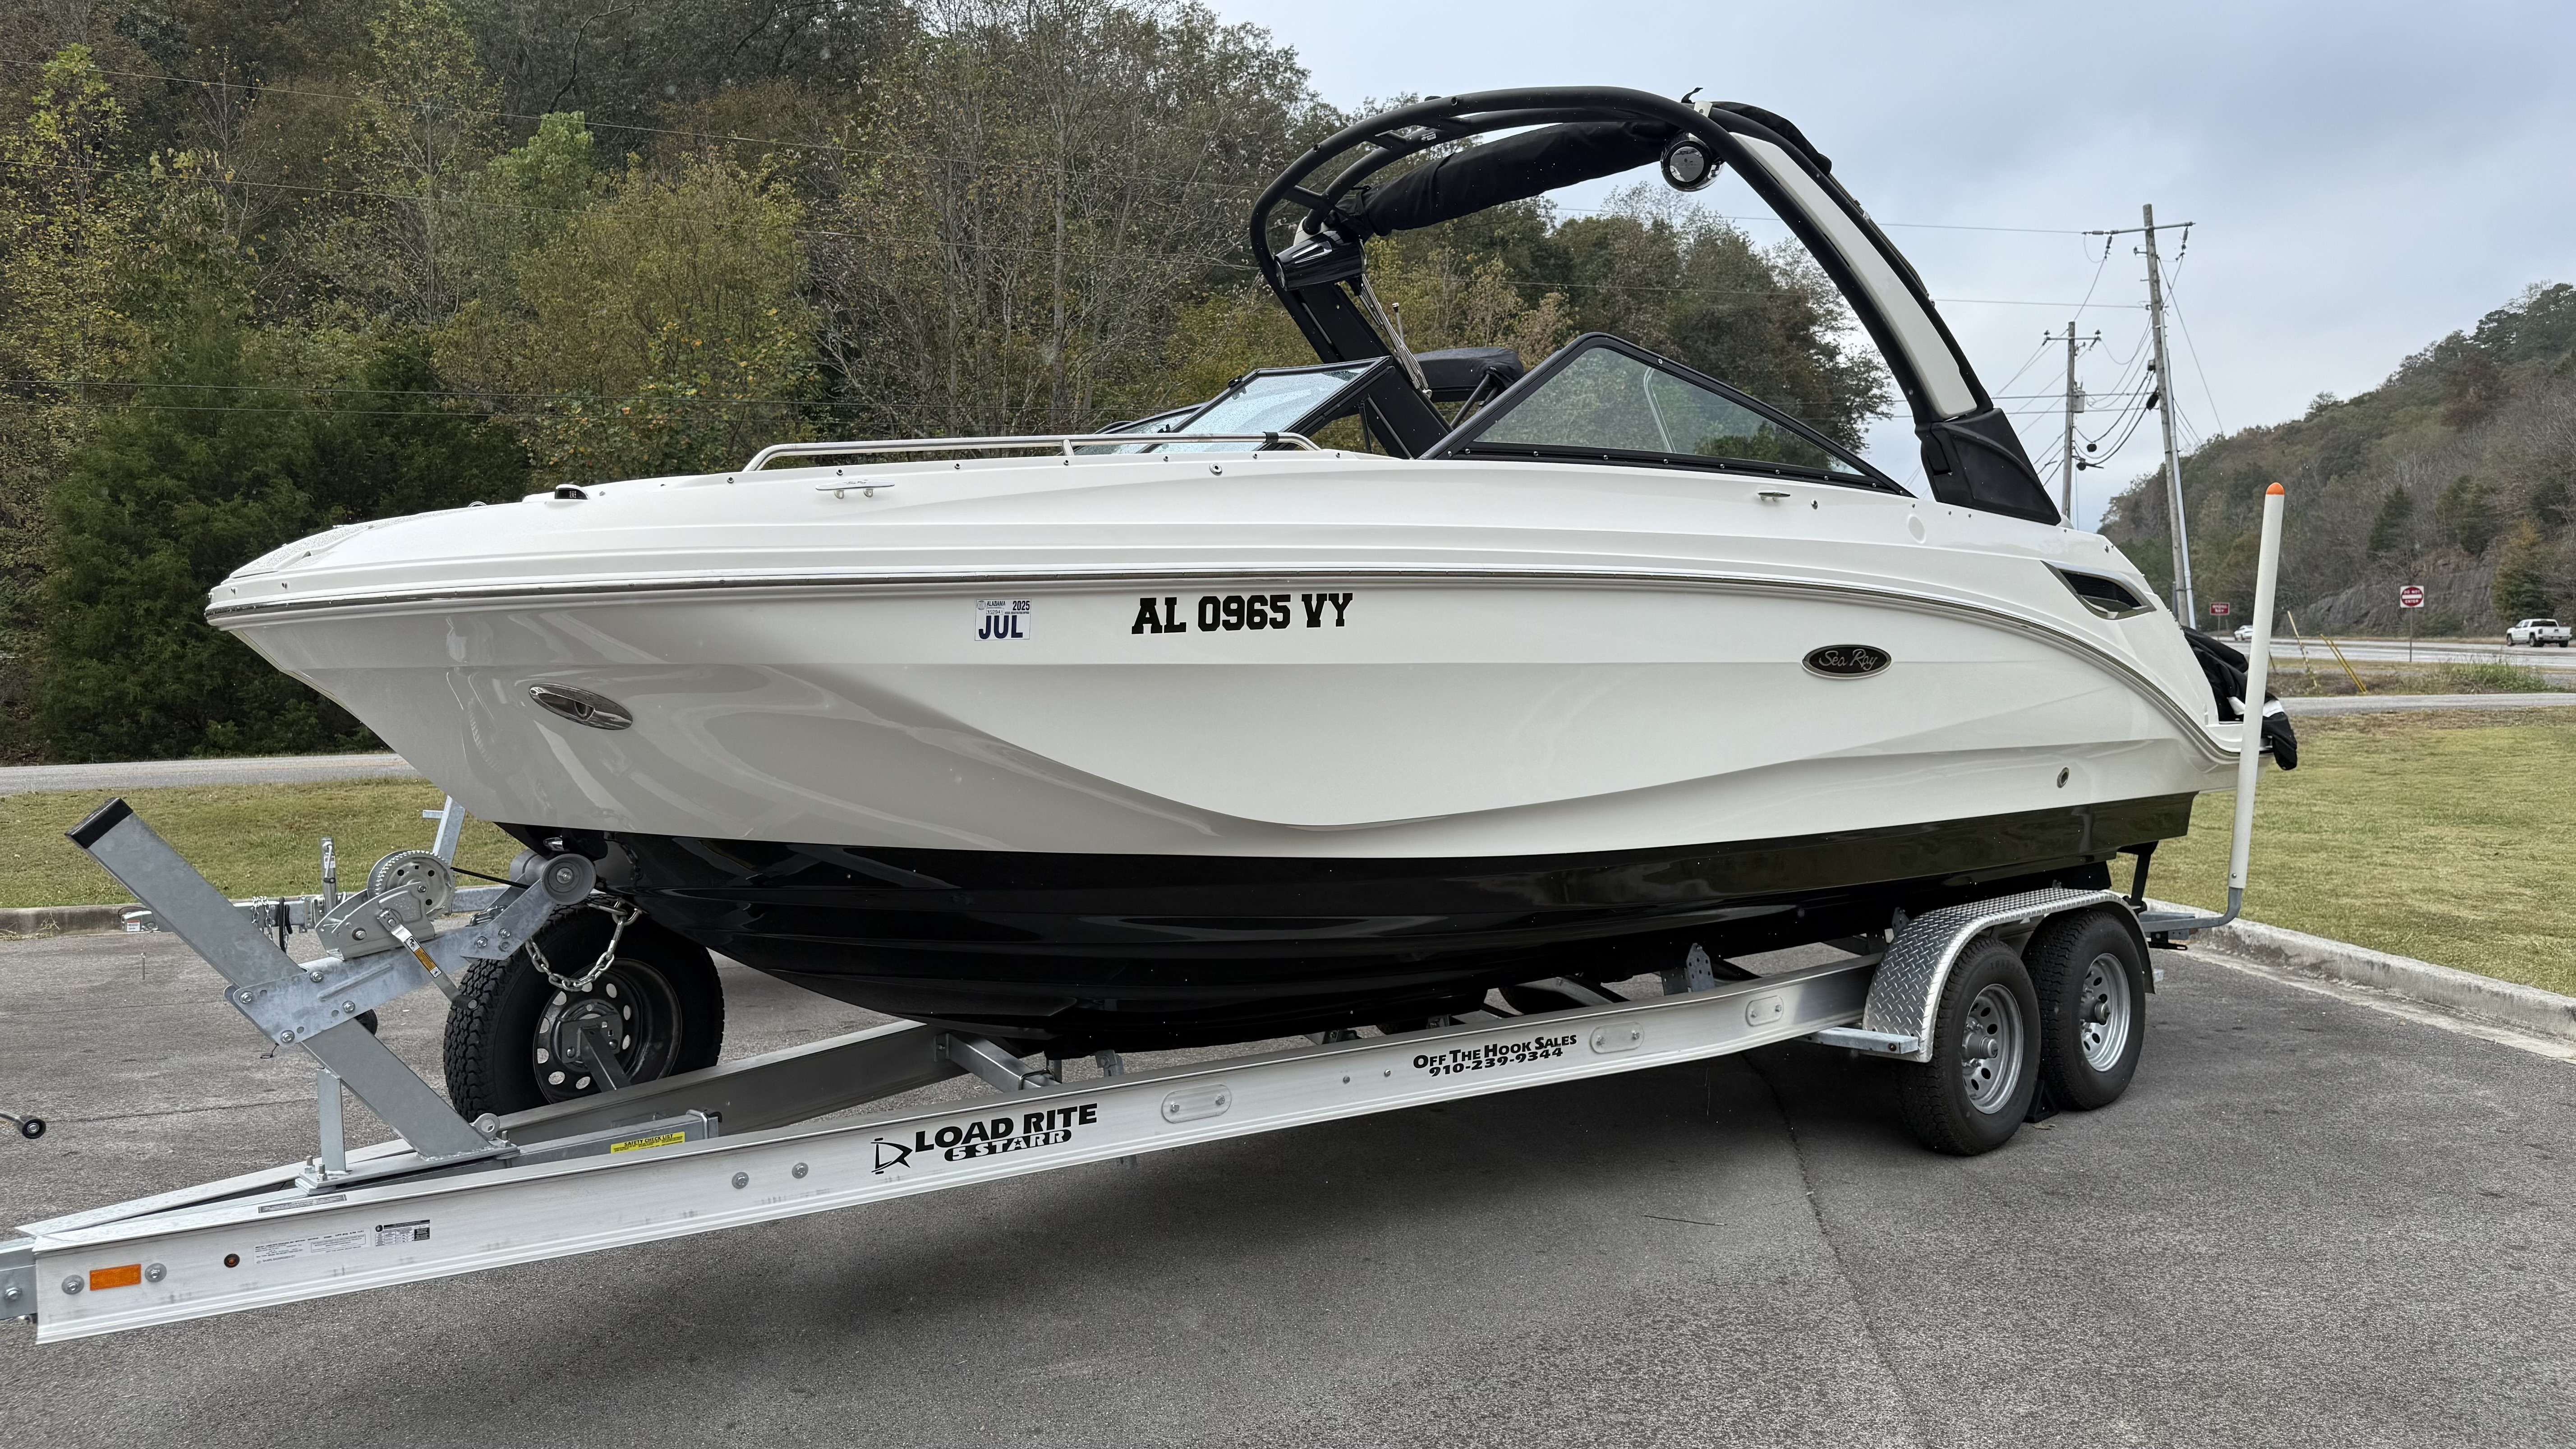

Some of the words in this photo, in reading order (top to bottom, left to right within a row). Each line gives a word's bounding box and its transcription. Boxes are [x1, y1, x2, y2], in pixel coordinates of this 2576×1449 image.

[1012, 600, 1030, 611] 2025
[1132, 597, 1187, 634] AL
[1198, 594, 1291, 632] 0965
[1302, 593, 1353, 628] VY
[979, 615, 1023, 639] JUL
[1819, 650, 1848, 667] Sea
[1849, 649, 1878, 671] Ray
[1413, 1054, 1447, 1069] OFF
[1449, 1049, 1481, 1063] THE
[1484, 1041, 1532, 1058] HOOK
[1534, 1035, 1577, 1050] SALES
[1429, 1048, 1563, 1077] 910-239-9344
[915, 1117, 1014, 1152] LOAD
[1023, 1103, 1098, 1134] RITE
[952, 1147, 966, 1160] 5
[975, 1131, 1065, 1156] STARR
